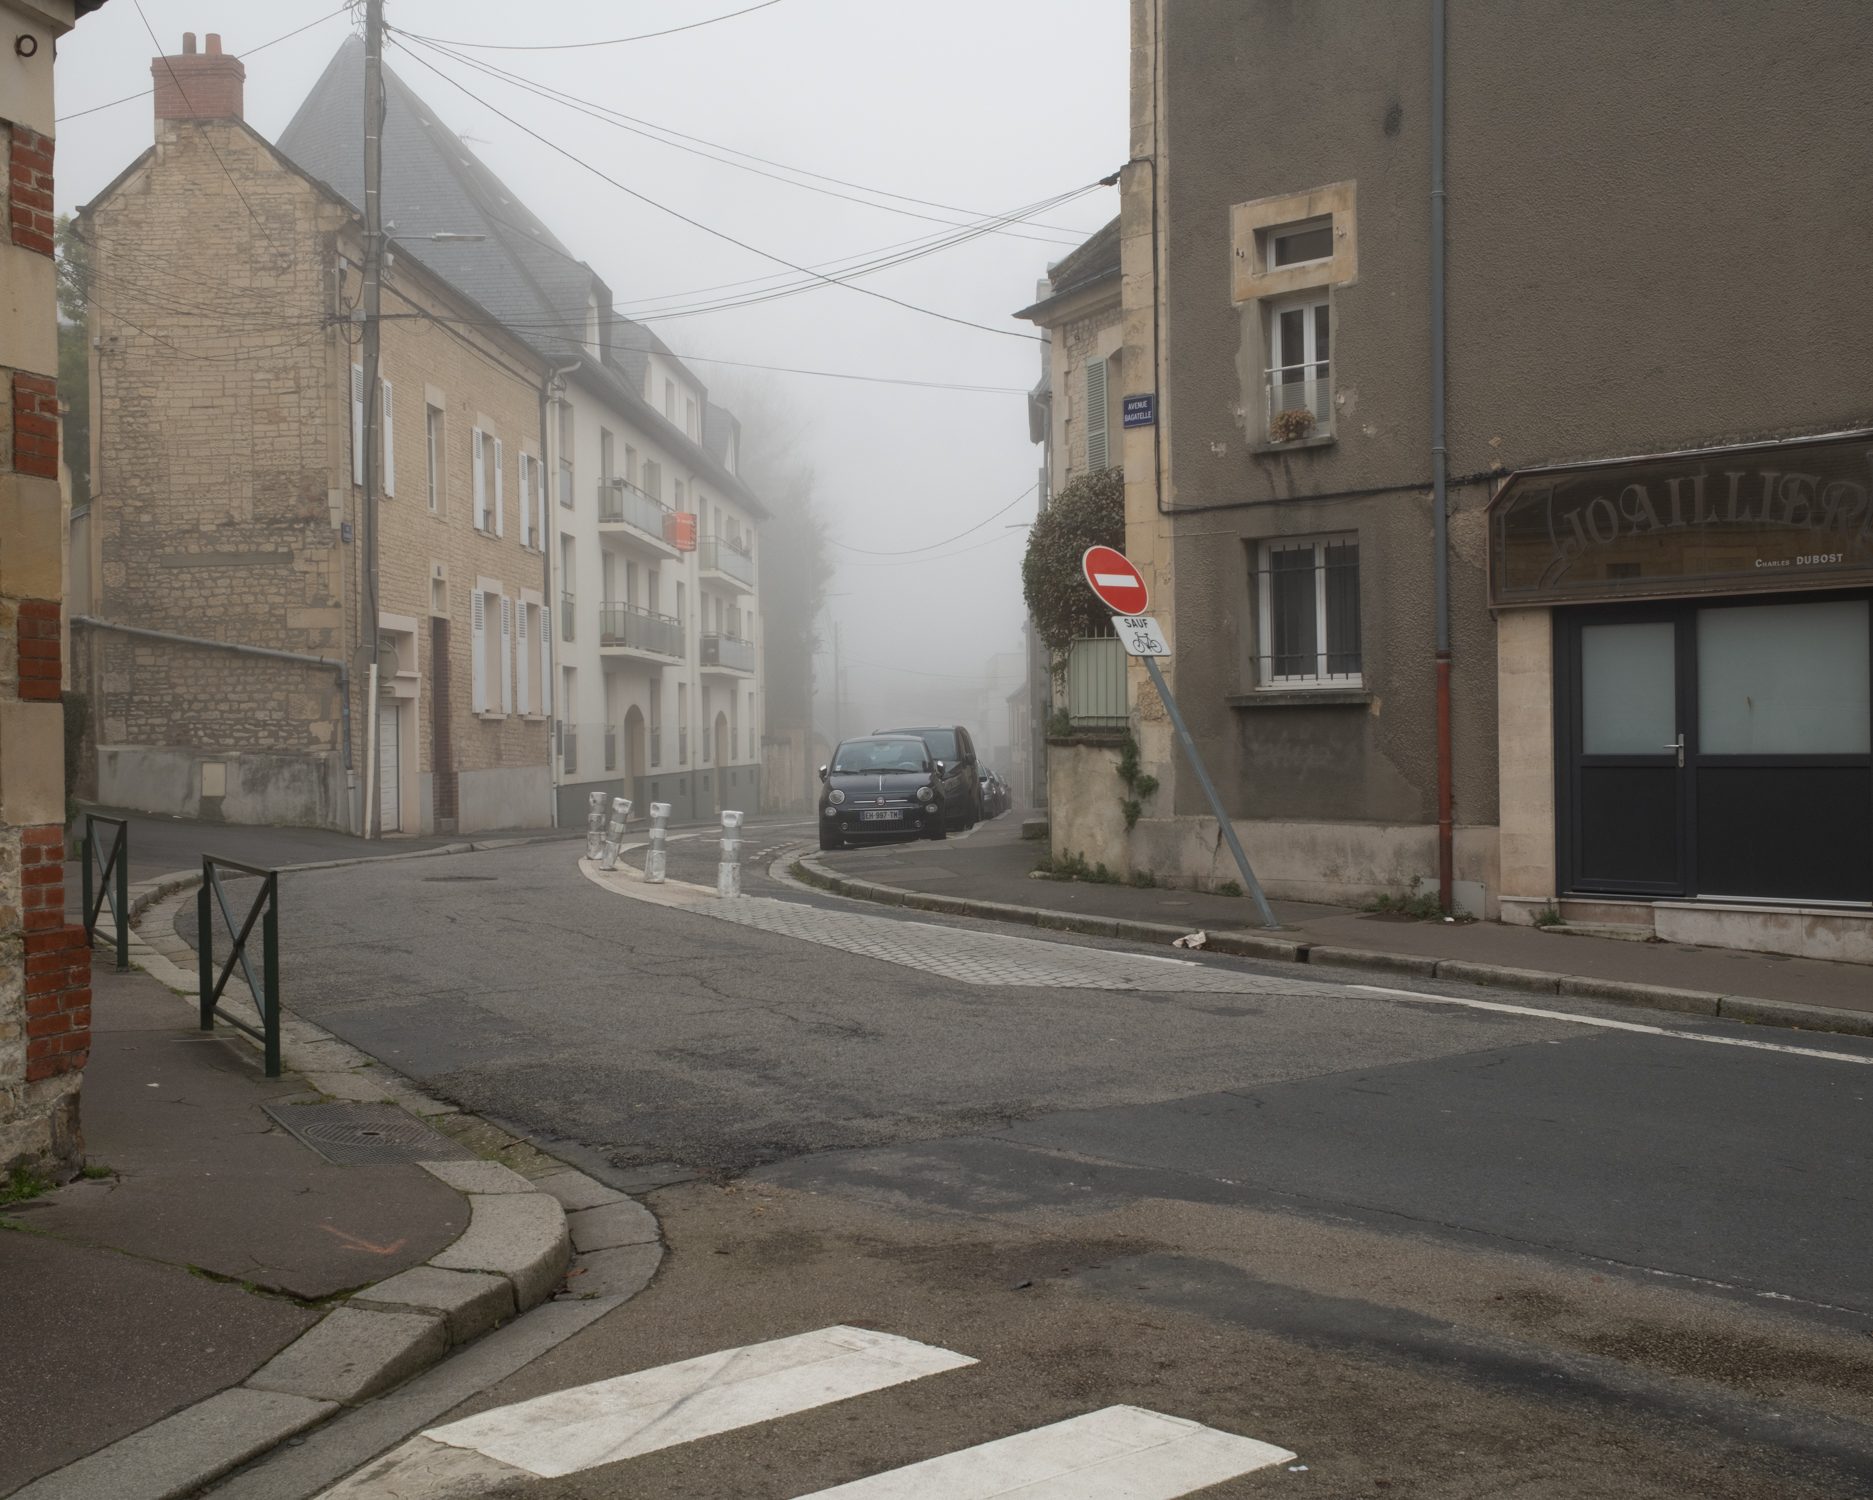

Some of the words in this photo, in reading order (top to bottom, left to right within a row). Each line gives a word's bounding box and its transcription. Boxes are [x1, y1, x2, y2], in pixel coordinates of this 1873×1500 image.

[1128, 400, 1148, 410] AVENUE
[1124, 410, 1152, 422] BAGATELLE
[1796, 553, 1844, 566] DUBOST
[1124, 618, 1149, 628] SAUF
